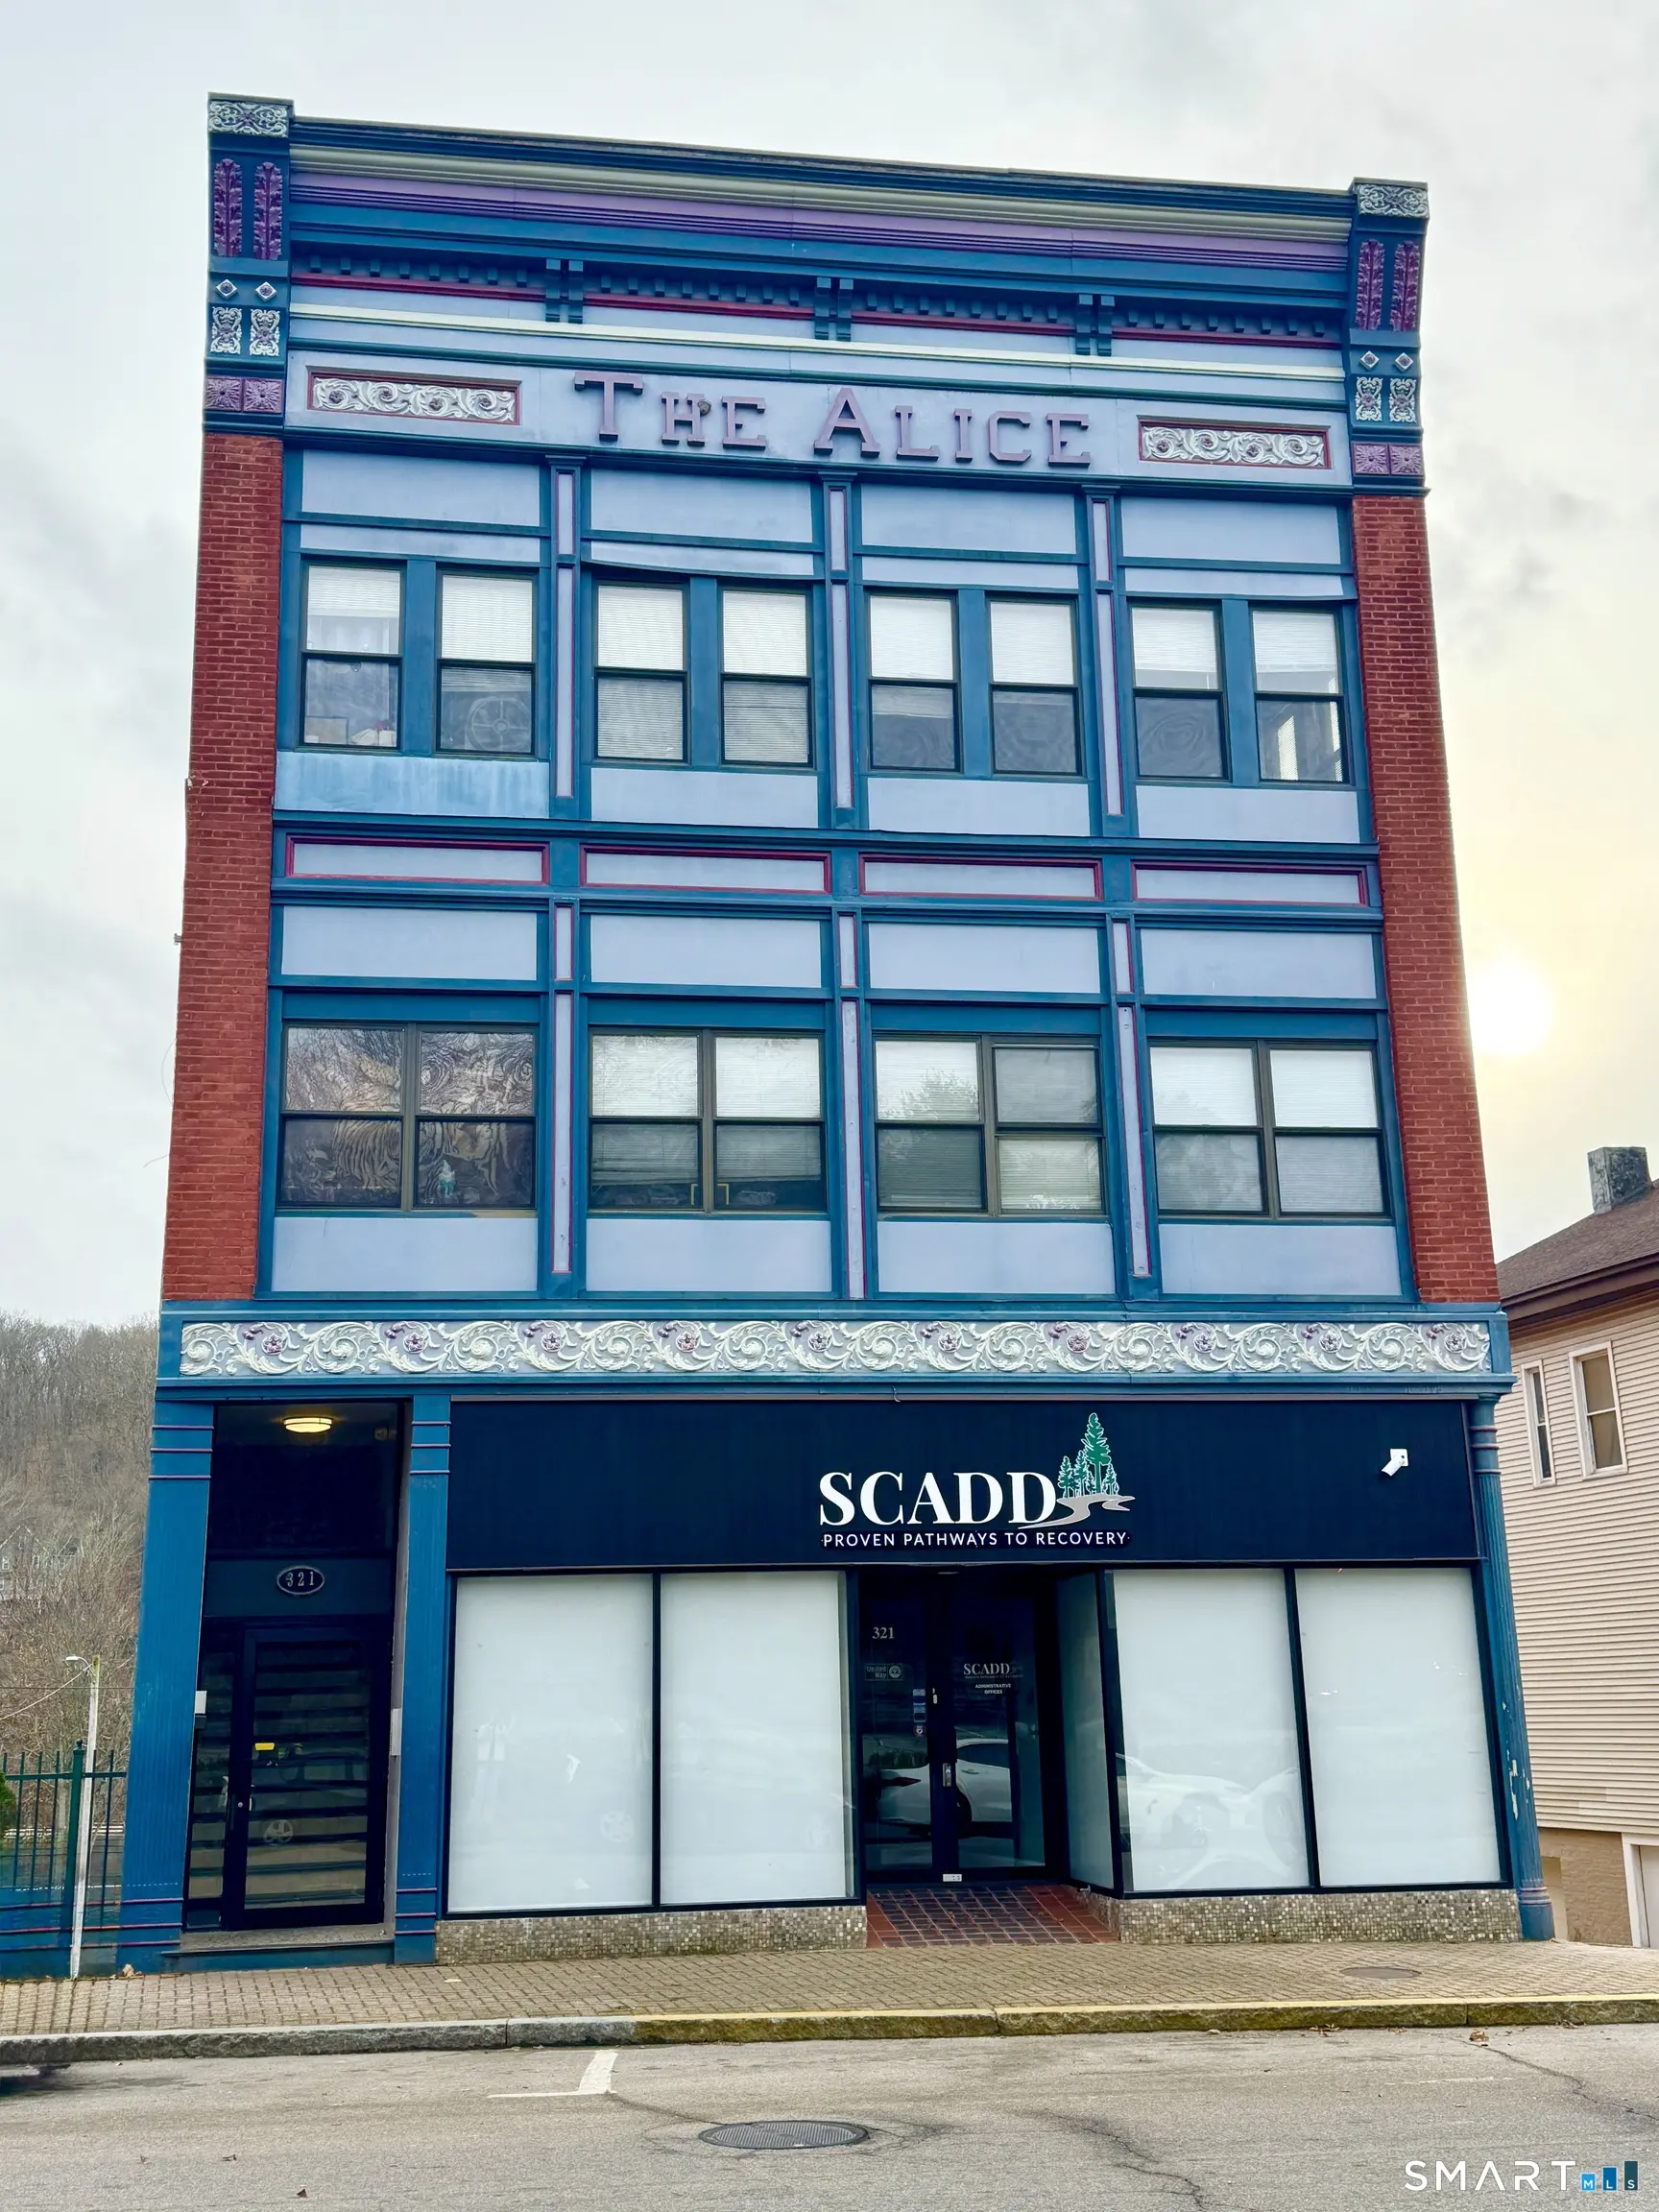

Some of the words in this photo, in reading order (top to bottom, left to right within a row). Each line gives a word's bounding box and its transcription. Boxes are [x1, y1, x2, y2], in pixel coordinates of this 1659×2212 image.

[573, 372, 768, 449] THE
[813, 387, 1092, 468] ALICE
[819, 1471, 1058, 1527] SCADD
[823, 1533, 895, 1548] PROVEN
[903, 1532, 998, 1547] PATHWAYS
[1005, 1531, 1028, 1546] TO
[1036, 1530, 1127, 1546] RECOVERY
[286, 1572, 314, 1587] 321
[872, 1627, 895, 1640] 321
[963, 1663, 1011, 1675] SCADD
